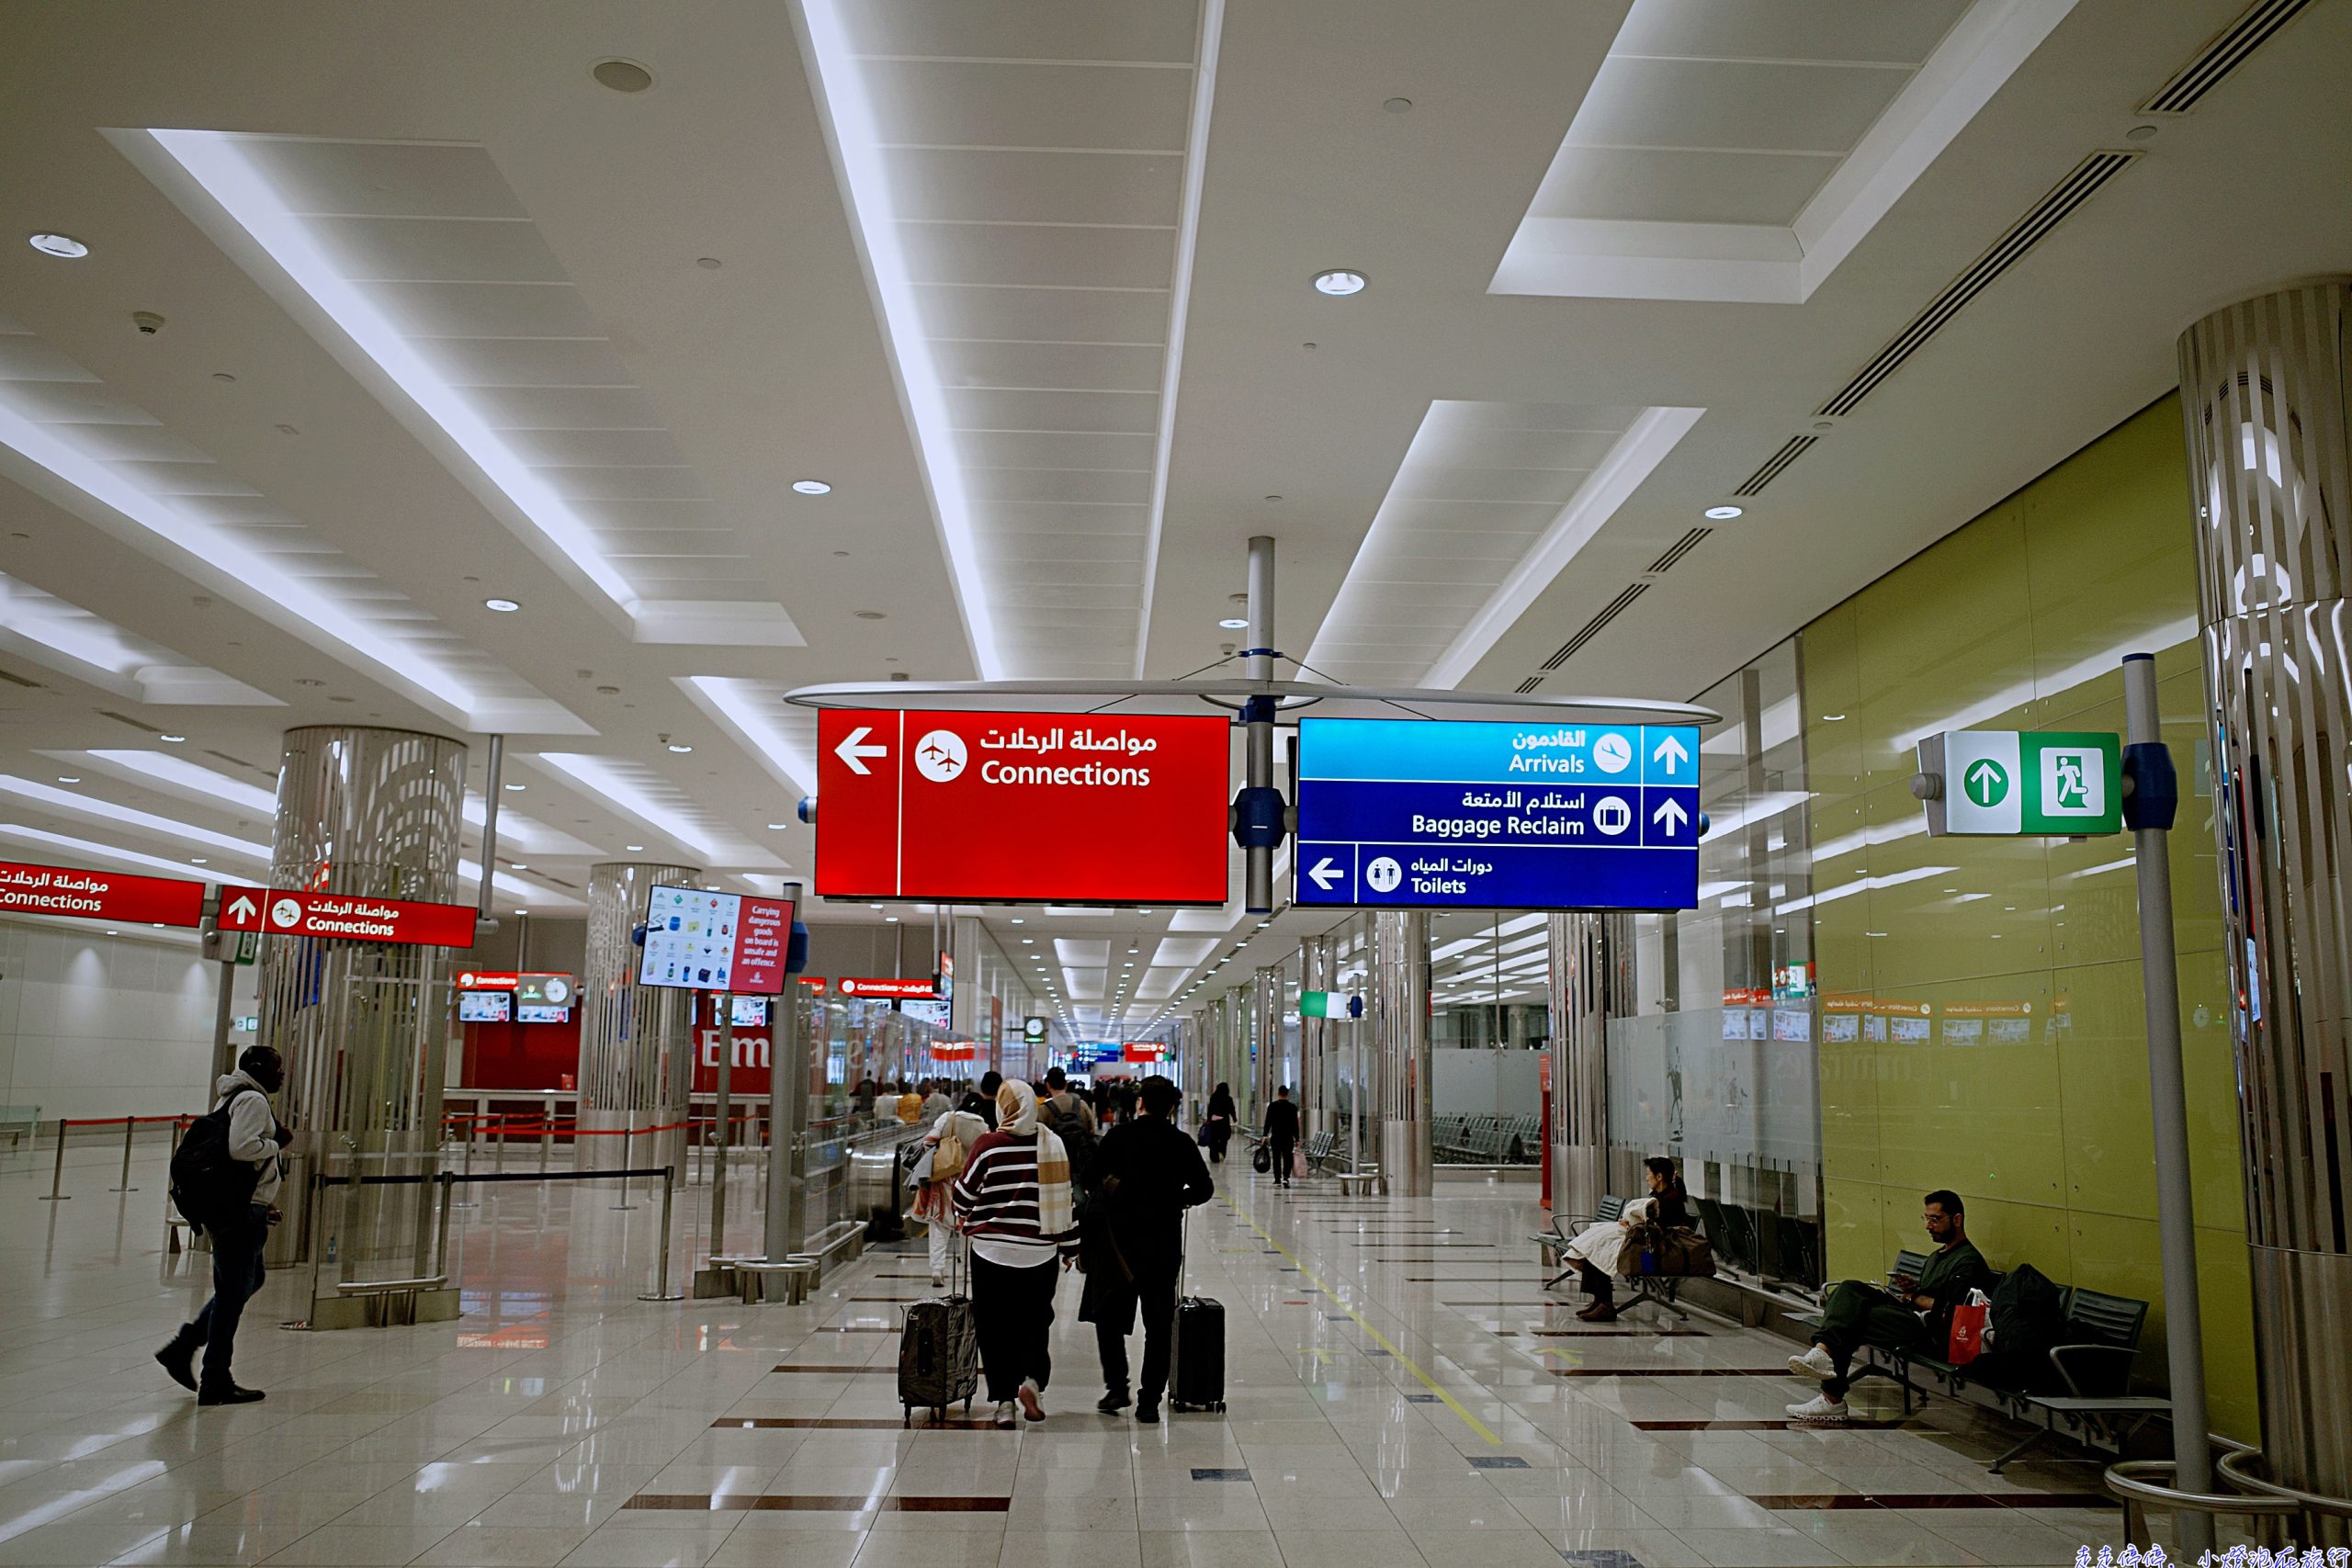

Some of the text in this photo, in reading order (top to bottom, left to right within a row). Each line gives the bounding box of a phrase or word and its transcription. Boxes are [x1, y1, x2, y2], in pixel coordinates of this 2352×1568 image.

[979, 728, 1158, 756] مواصلة الرحلات
[1512, 729, 1586, 750] القادمون
[1509, 754, 1585, 773] Arrivals
[981, 761, 1150, 786] Connections
[1462, 790, 1585, 816] استلام الأمتعة
[1412, 815, 1585, 838] Baggage Reclaim
[1410, 857, 1493, 875] دورات المياه
[52, 874, 108, 894] مواصلة
[1410, 877, 1467, 894] Toilets
[307, 900, 400, 920] مواصلة الرحلات
[752, 906, 780, 918] Carrying
[306, 916, 394, 936] Connections
[749, 917, 781, 927] dangerous
[753, 928, 773, 936] goods
[754, 937, 773, 946] board
[764, 949, 778, 957] and
